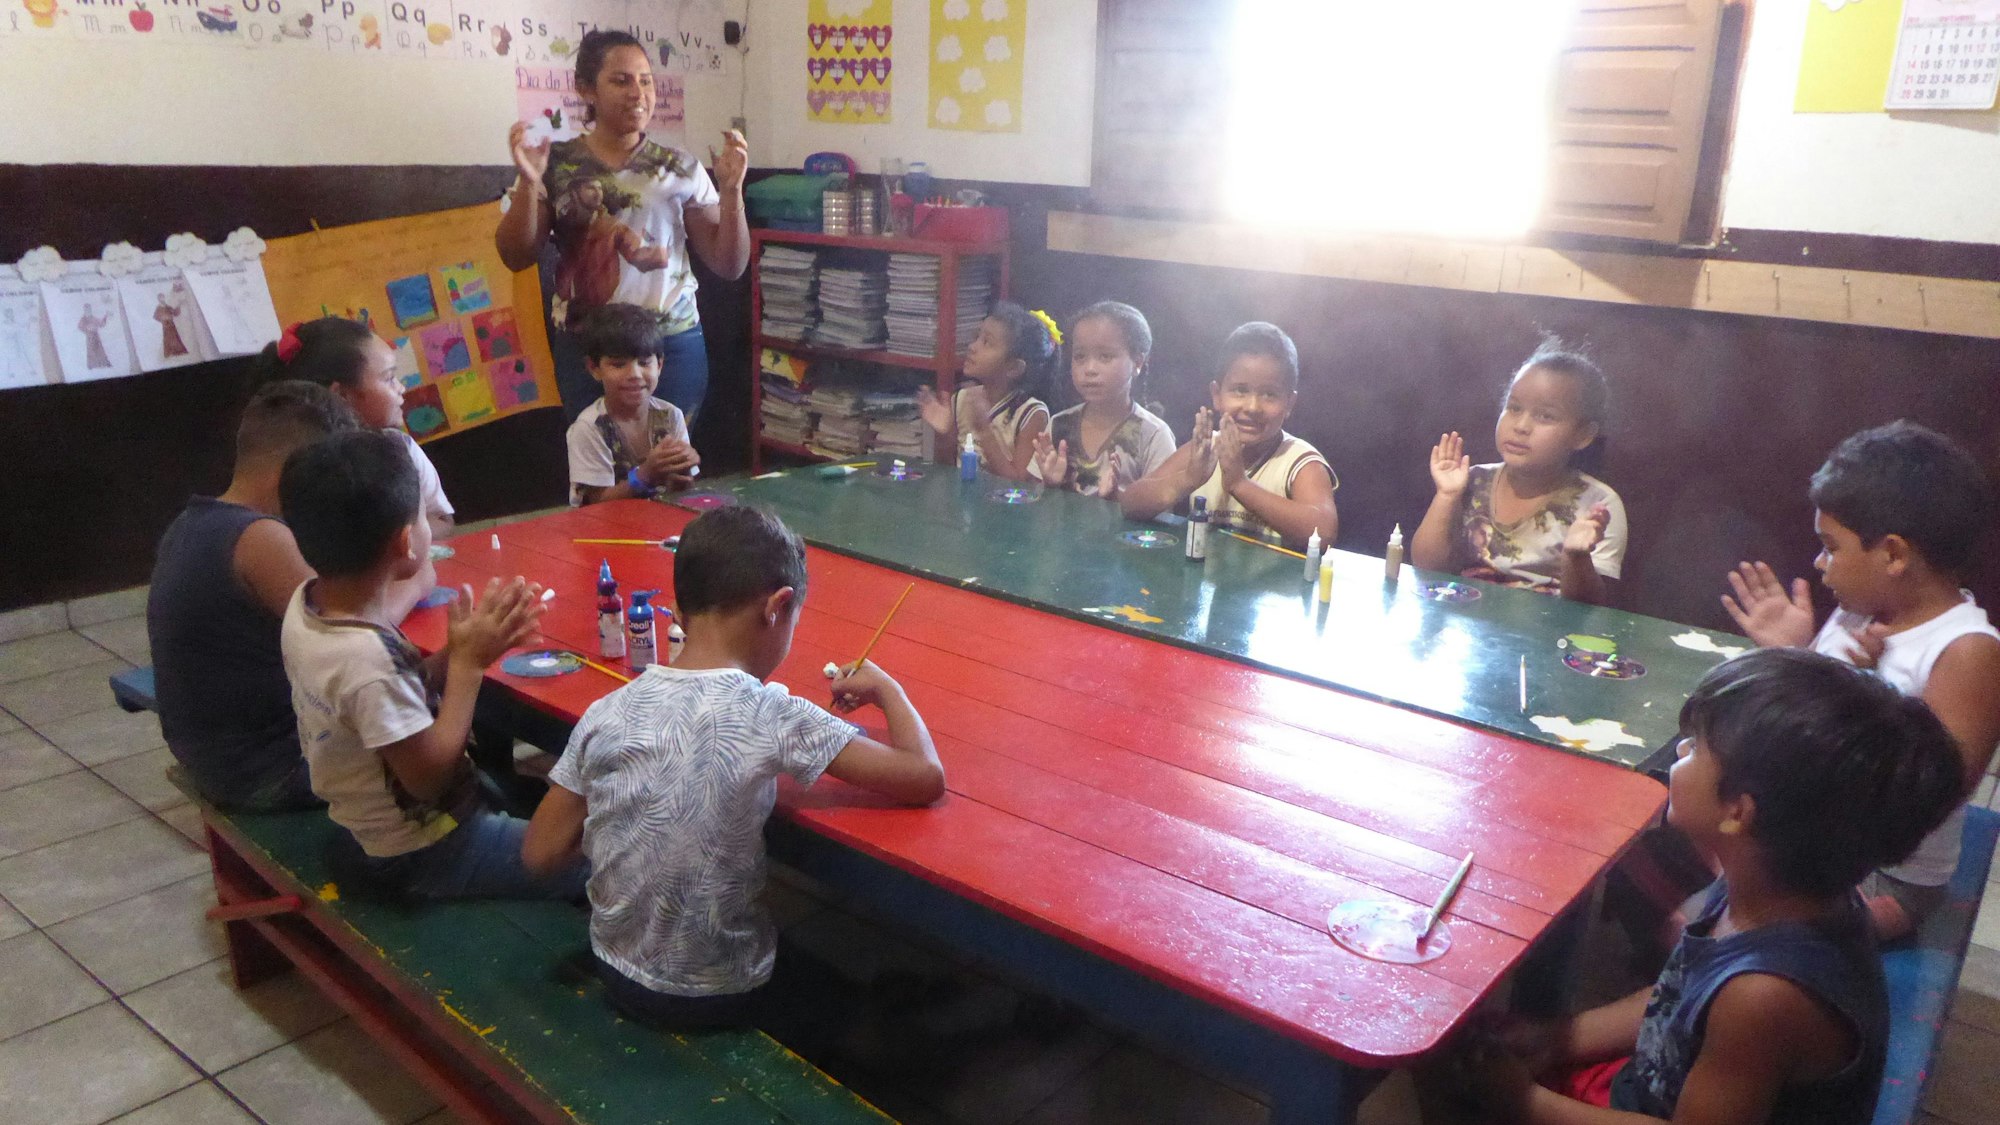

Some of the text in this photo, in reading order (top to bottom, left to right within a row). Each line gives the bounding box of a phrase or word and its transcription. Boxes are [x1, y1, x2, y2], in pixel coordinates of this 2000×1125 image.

[1940, 29, 1947, 39] 2
[1954, 28, 1960, 39] 3
[1949, 44, 1959, 54] 10
[1907, 58, 1998, 69] 14 15 16 17 18 19 20
[1904, 73, 1993, 84] 21 22 23 24 25 26 27
[1913, 89, 1924, 99] 29
[1926, 89, 1937, 99] 30
[1939, 89, 1950, 99] 31
